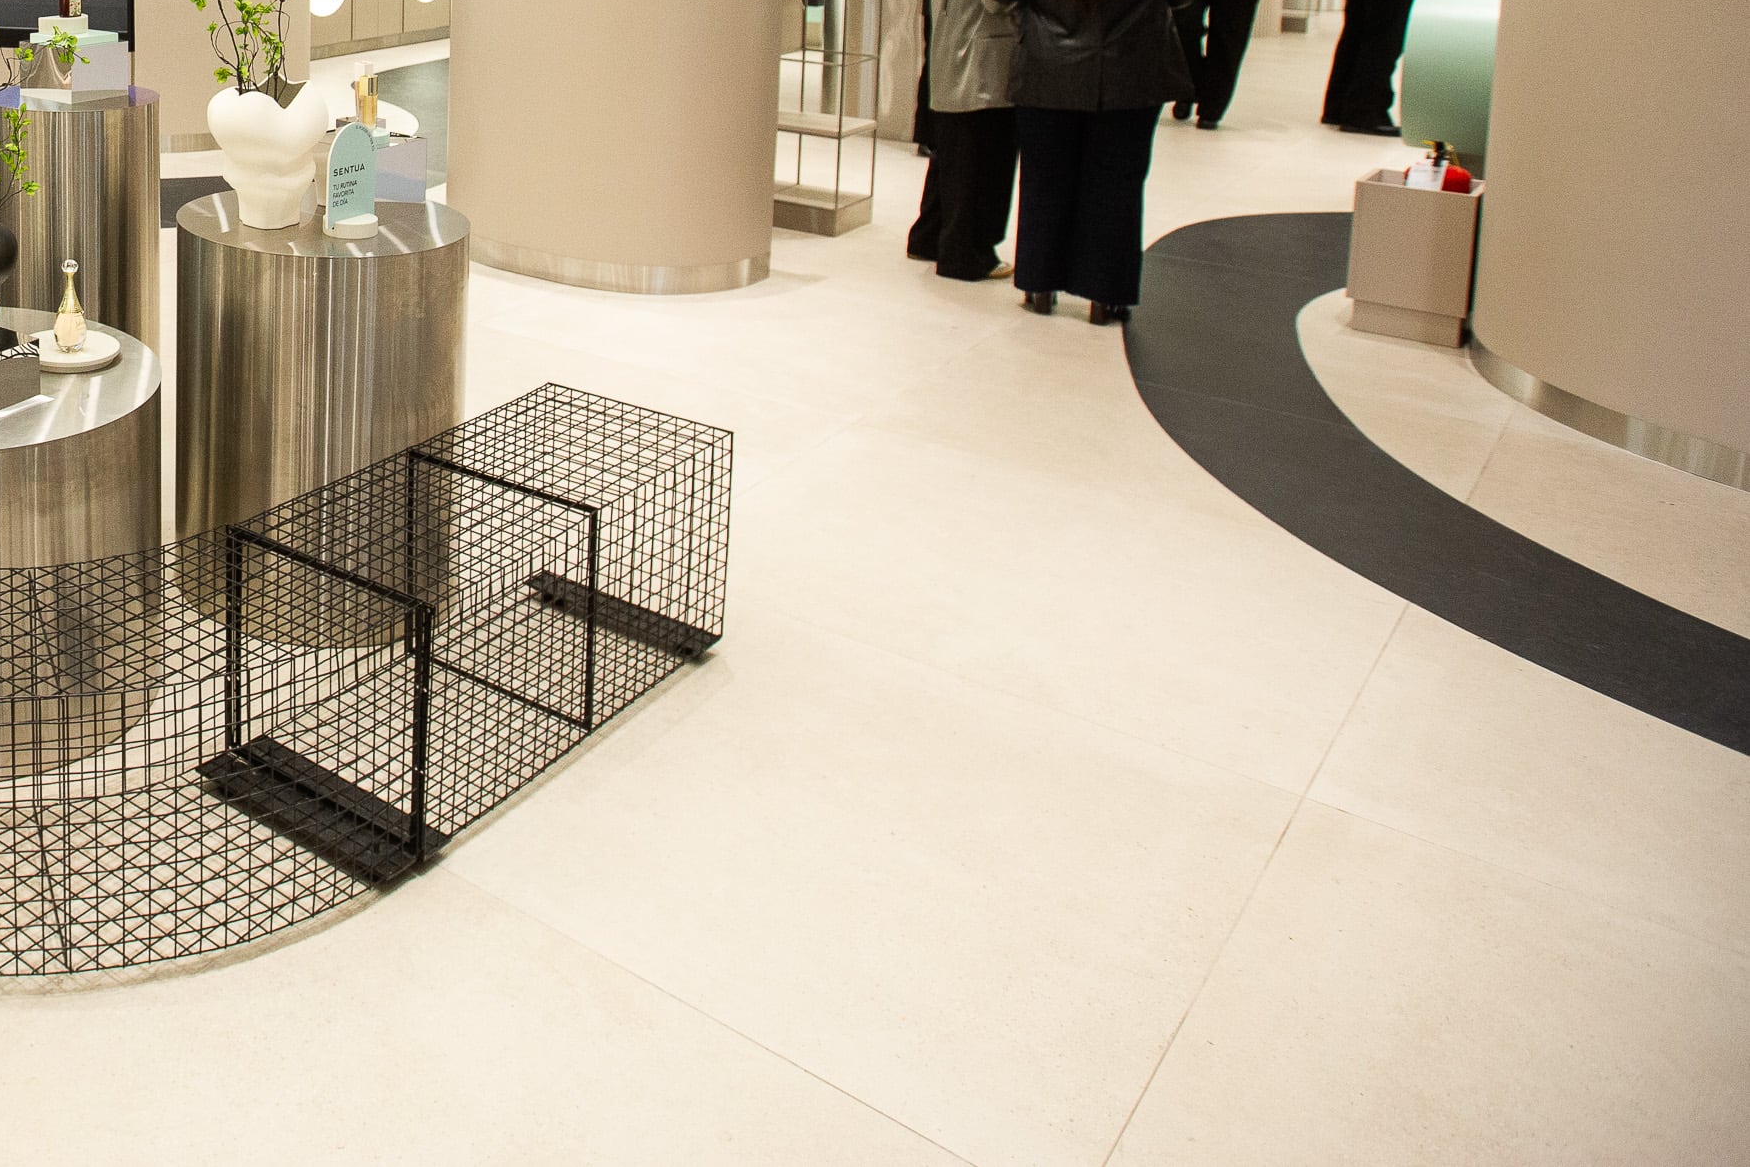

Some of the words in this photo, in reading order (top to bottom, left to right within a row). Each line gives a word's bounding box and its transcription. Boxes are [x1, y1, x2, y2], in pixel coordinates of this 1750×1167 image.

[333, 163, 366, 177] SENTUA
[333, 183, 340, 191] TU
[340, 180, 358, 190] RUTINA
[332, 188, 355, 198] FAVORITA
[332, 200, 340, 208] DE
